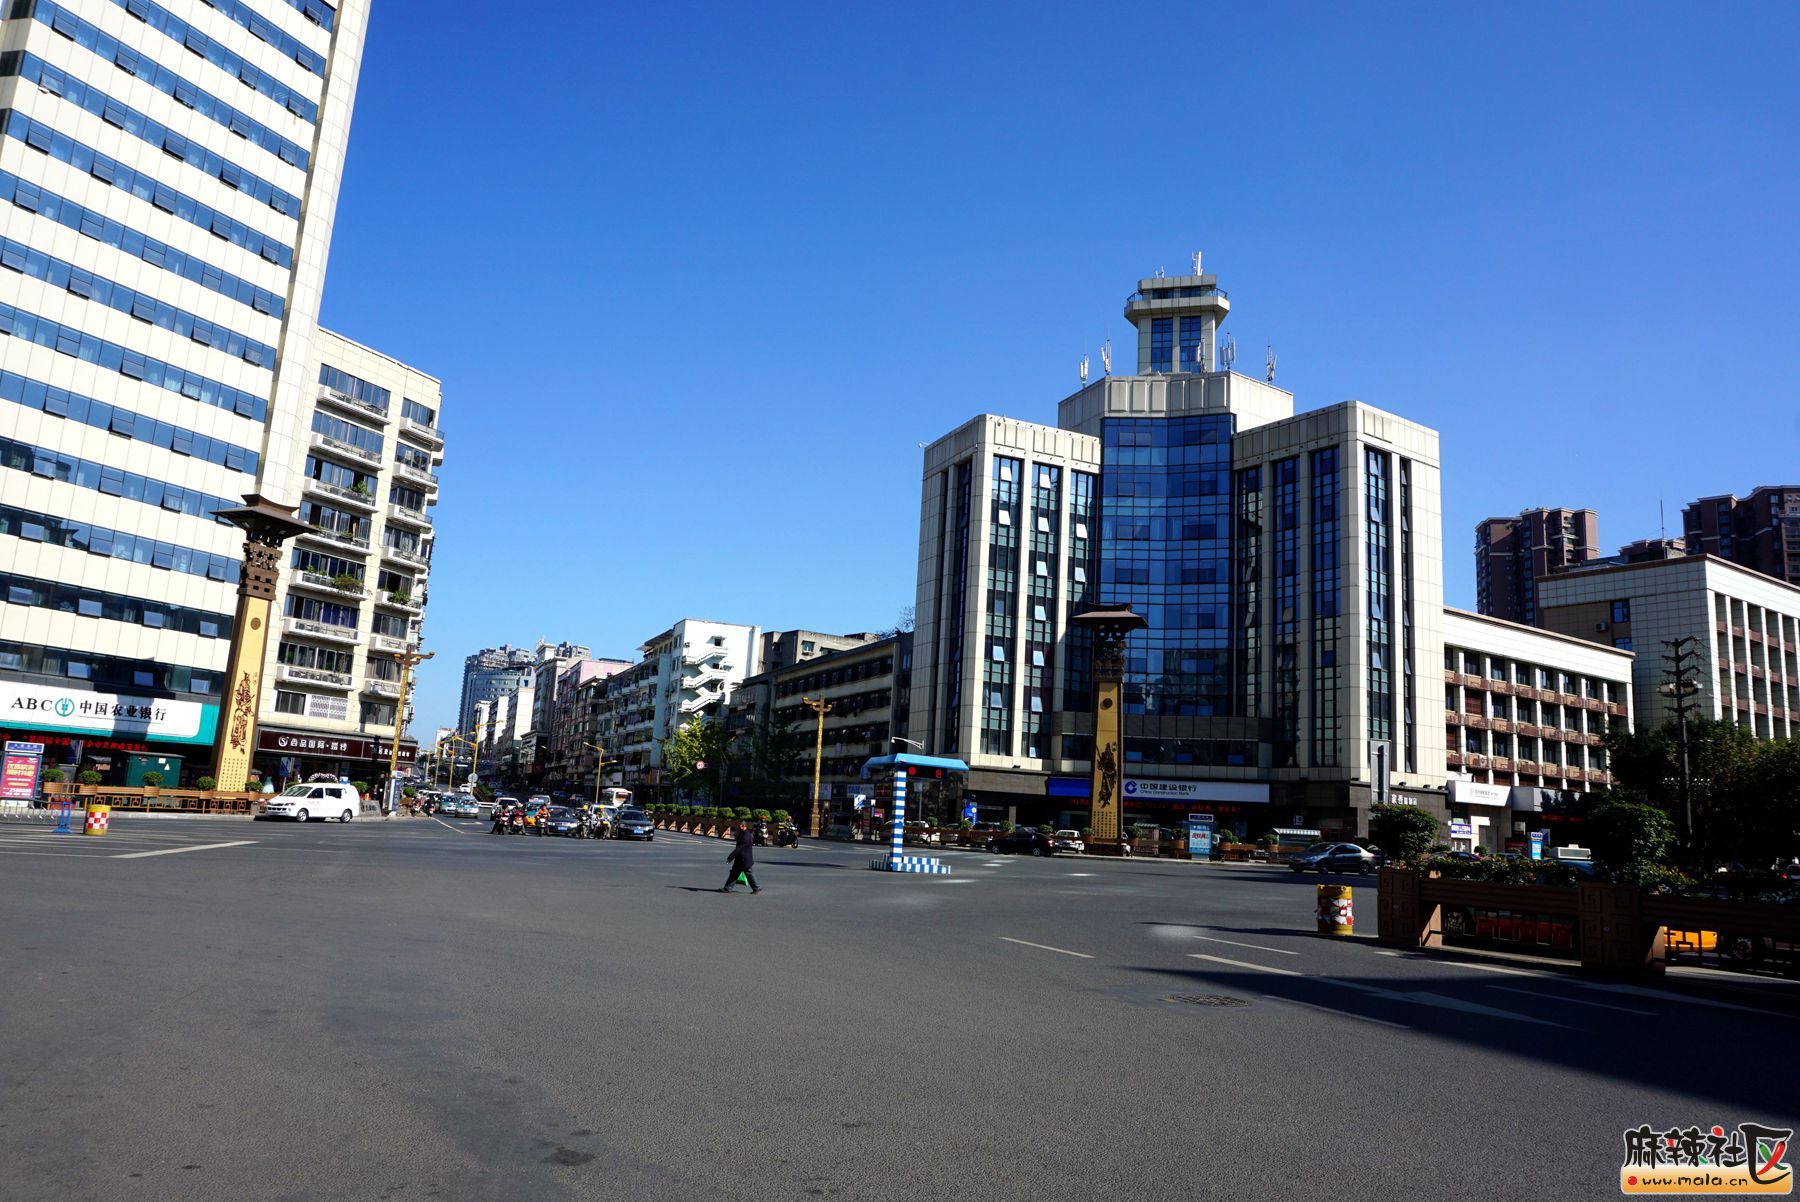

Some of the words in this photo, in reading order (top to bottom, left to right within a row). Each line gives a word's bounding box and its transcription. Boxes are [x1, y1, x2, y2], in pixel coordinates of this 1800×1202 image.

[11, 697, 53, 711] ABC
[80, 700, 167, 721] 中国农业银行
[1140, 783, 1197, 792] 中国建设银行
